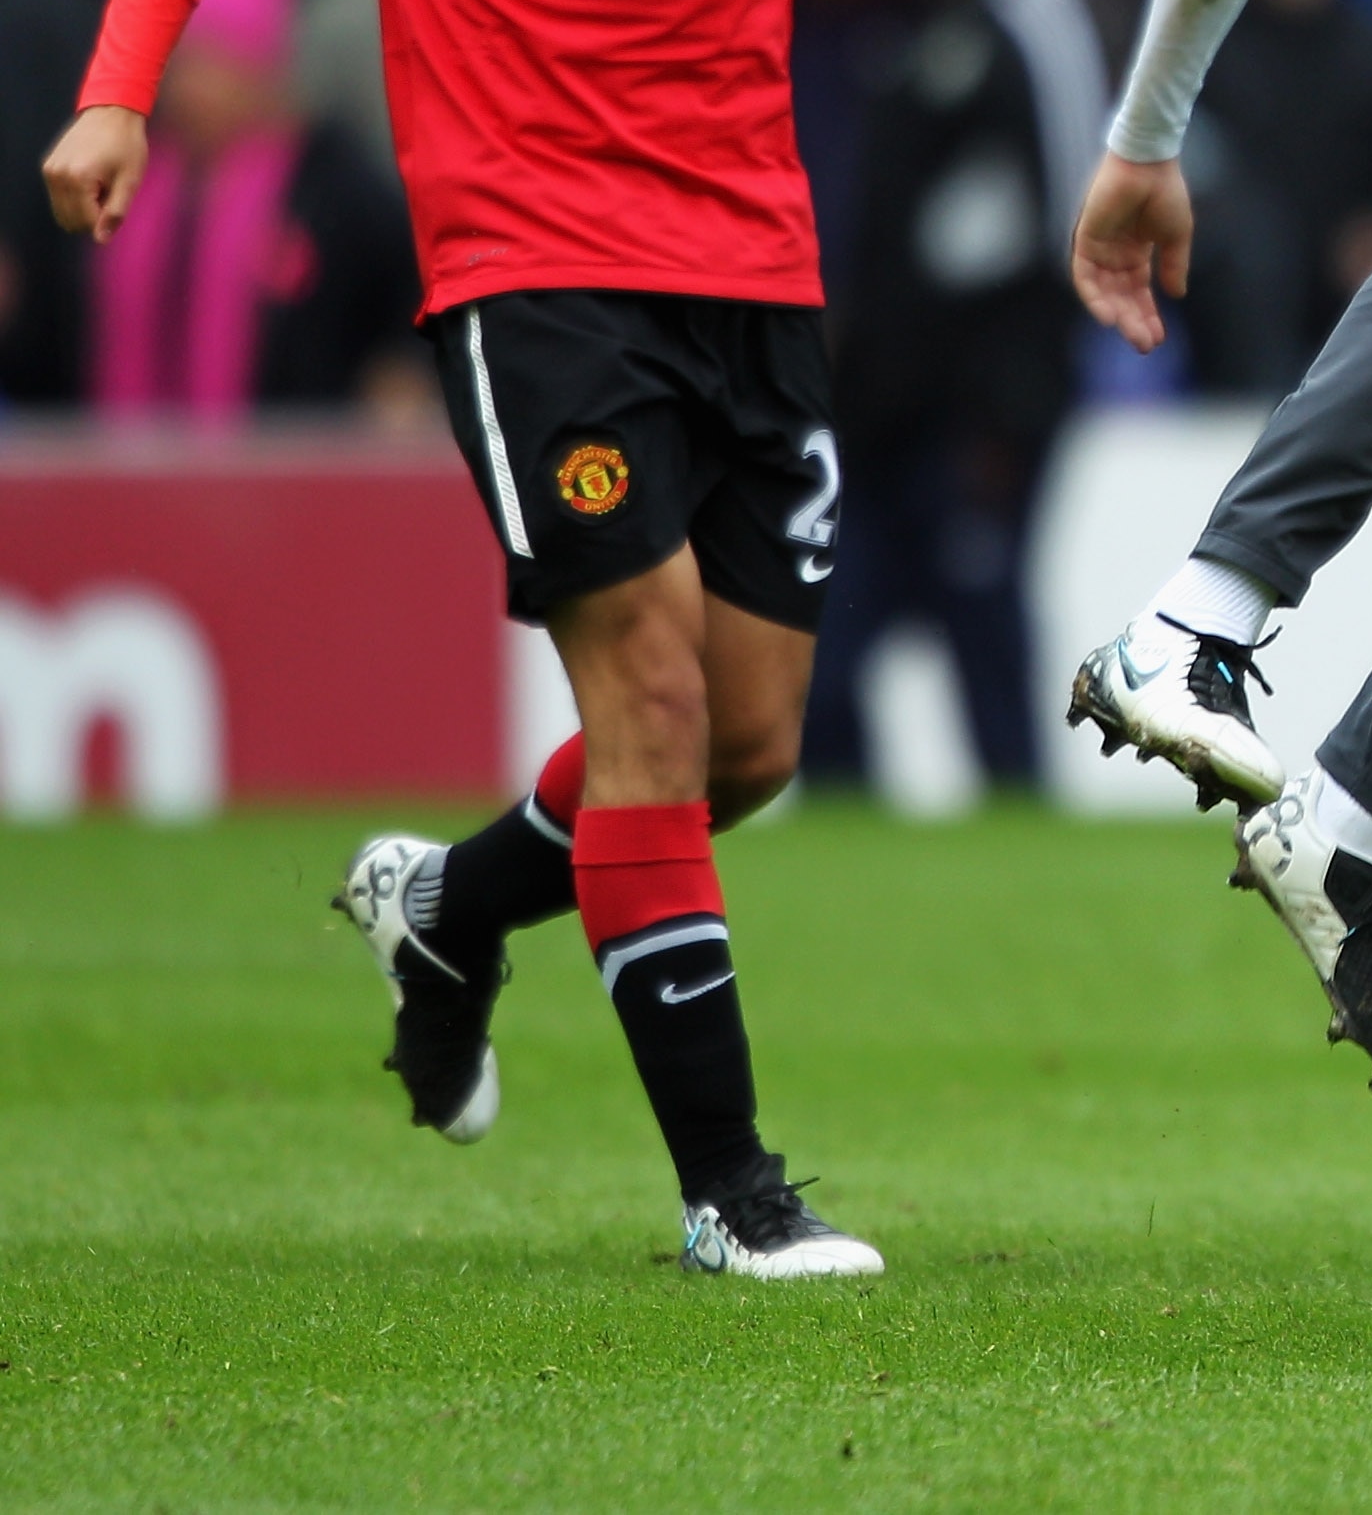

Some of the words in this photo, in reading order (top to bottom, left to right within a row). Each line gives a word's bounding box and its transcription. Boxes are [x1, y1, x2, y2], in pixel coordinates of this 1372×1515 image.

[563, 450, 618, 481] MANCHESTER
[585, 491, 621, 510] UNITED
[785, 428, 840, 548] 2
